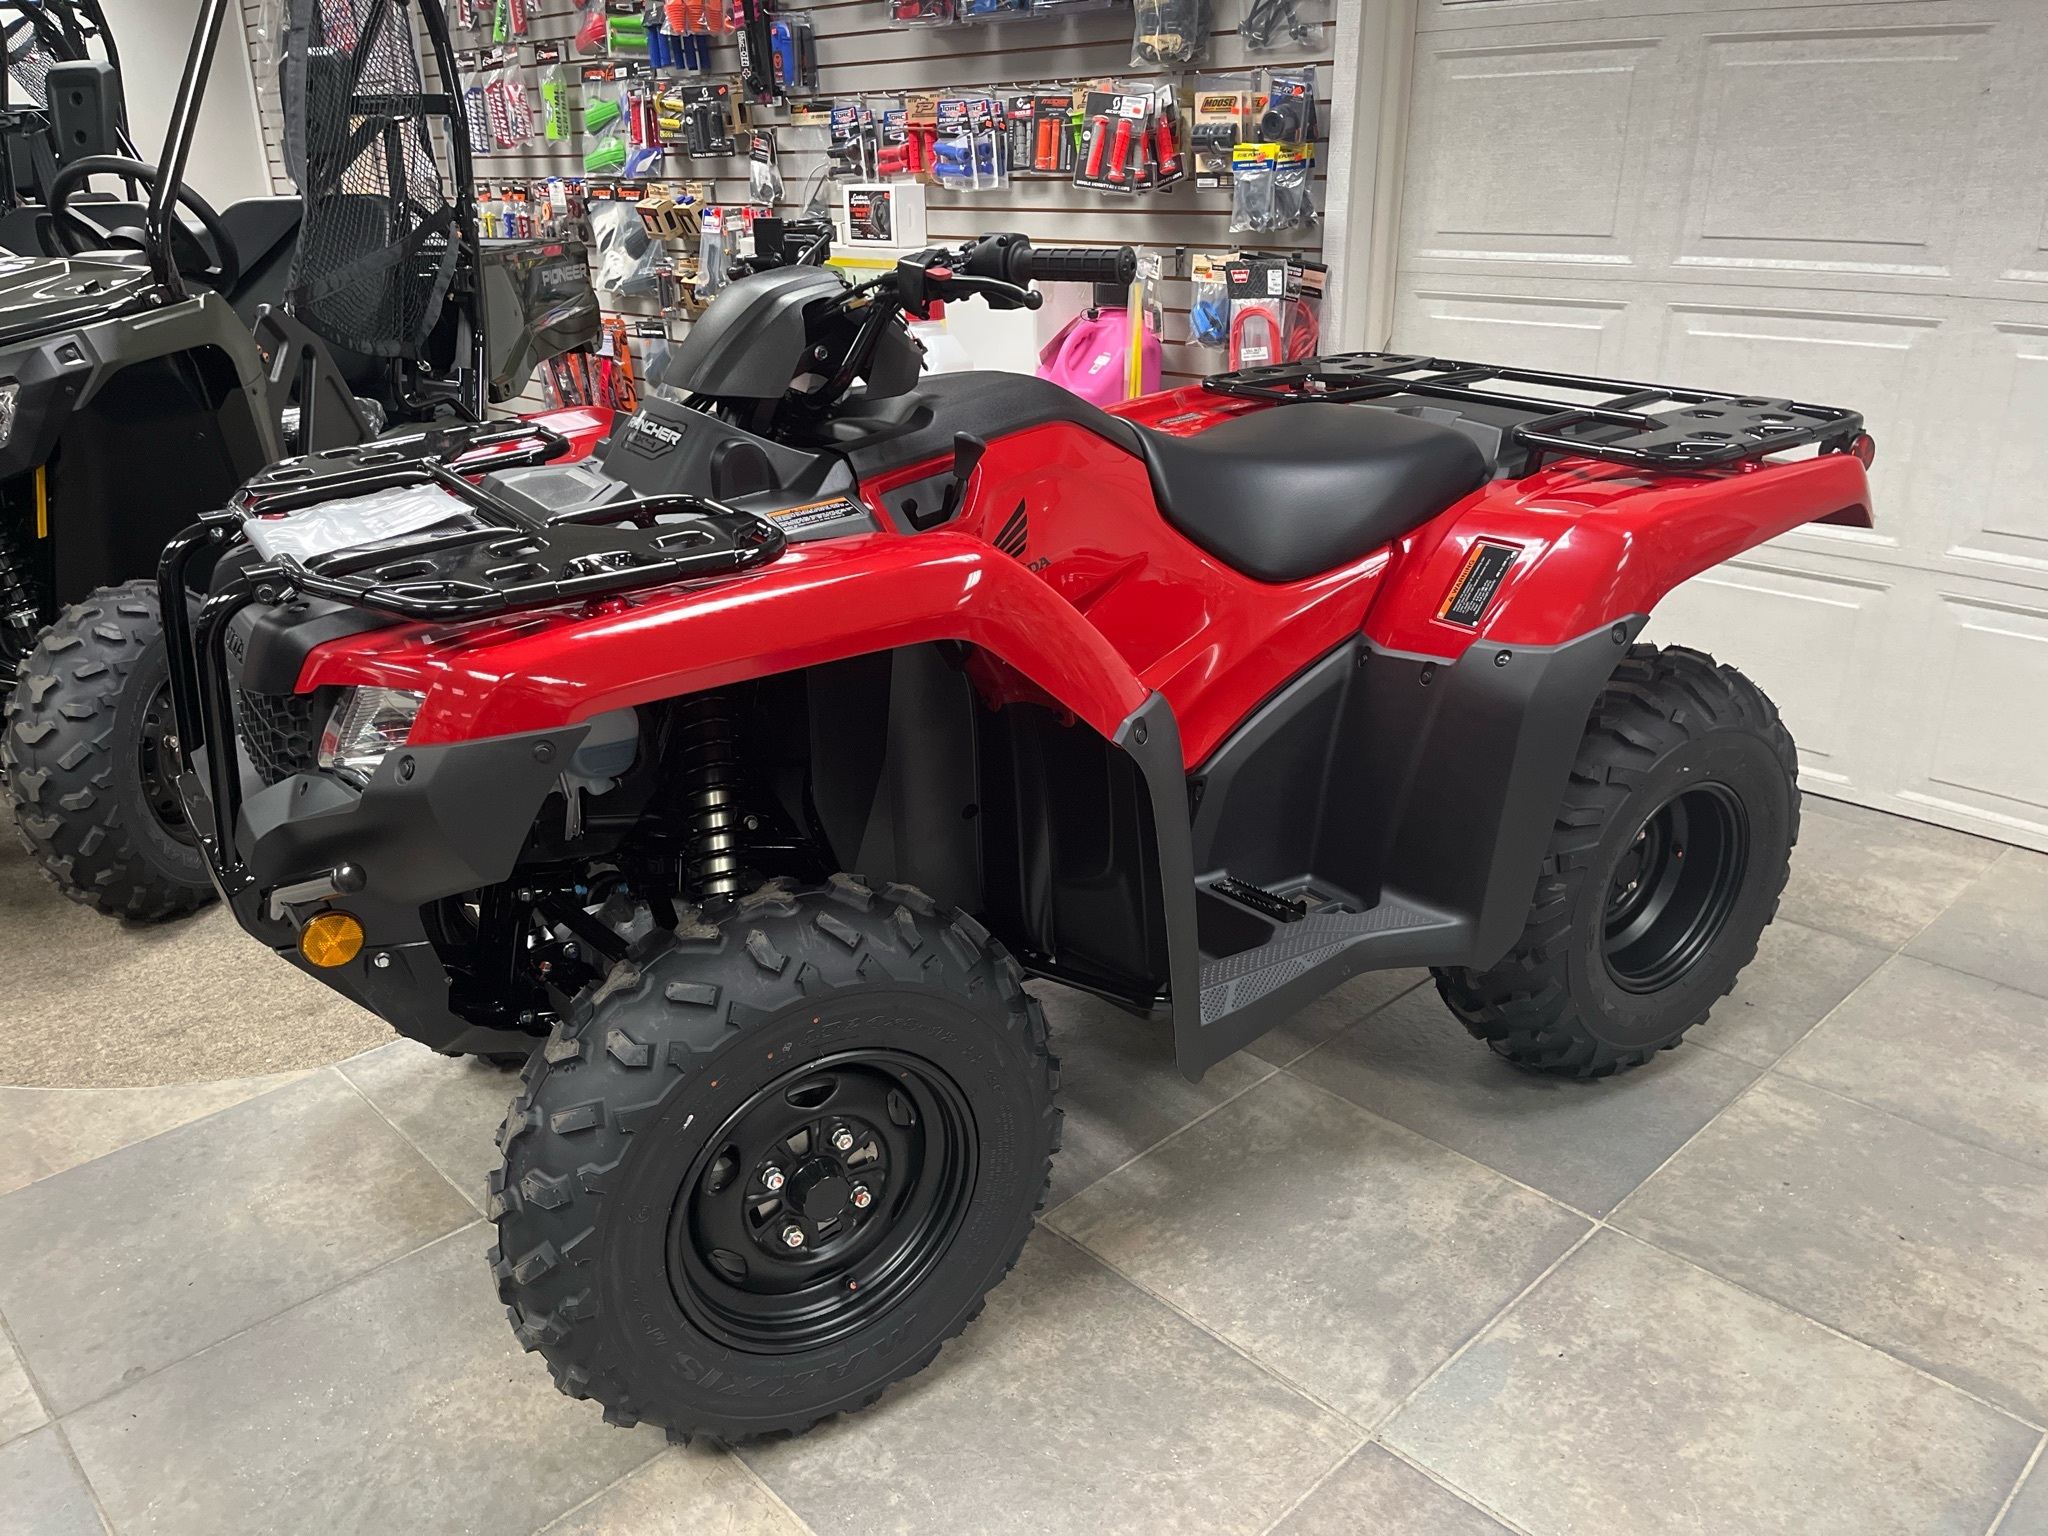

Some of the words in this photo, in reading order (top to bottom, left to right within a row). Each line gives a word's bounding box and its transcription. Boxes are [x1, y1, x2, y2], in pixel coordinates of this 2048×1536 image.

[469, 91, 482, 151] RENTHAL
[475, 92, 489, 150] RENTHAL
[495, 86, 511, 144] RENTHAL
[553, 90, 563, 136] RENTHAL
[1204, 98, 1235, 107] MOOSE
[541, 263, 587, 287] PIONEER
[627, 416, 682, 446] RANCHER
[1452, 560, 1475, 594] WARNING
